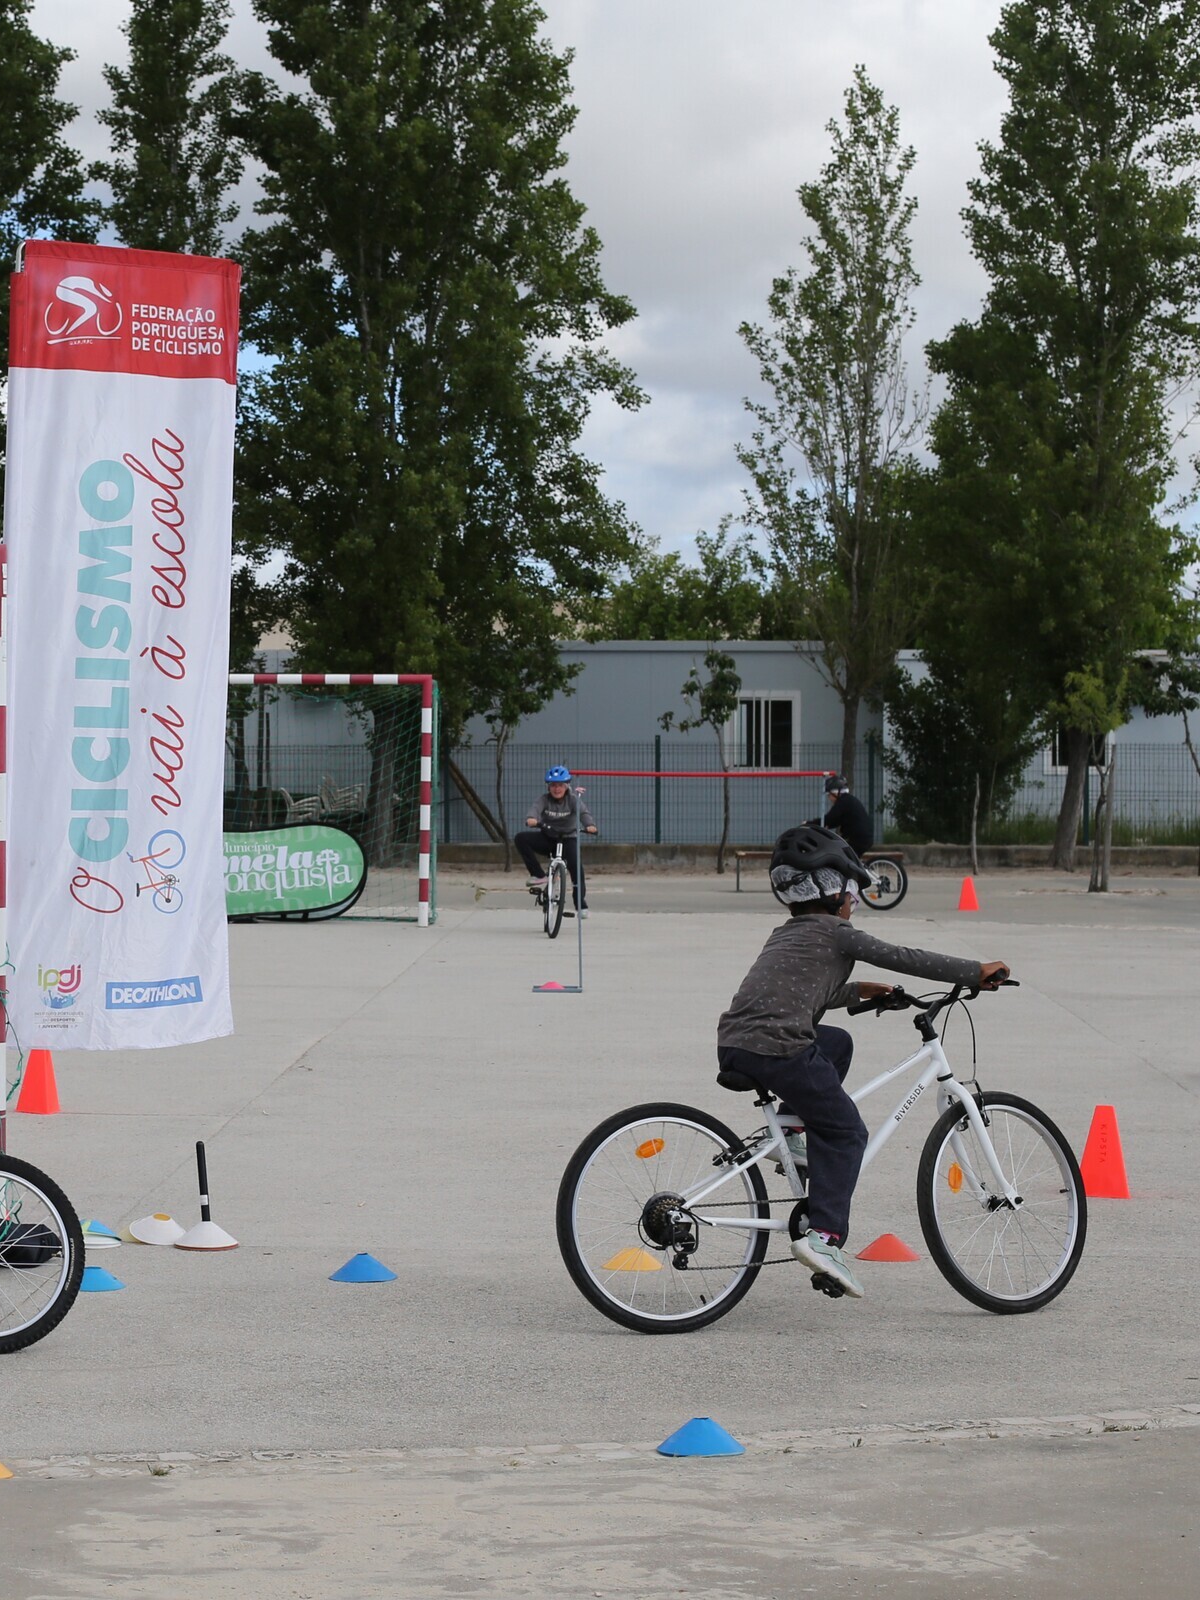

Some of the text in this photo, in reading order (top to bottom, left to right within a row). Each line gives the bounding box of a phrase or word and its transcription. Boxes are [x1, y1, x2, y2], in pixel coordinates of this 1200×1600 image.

[131, 303, 216, 326] FEDERAÇÃO
[131, 321, 225, 341] PORTUGUESA
[131, 337, 222, 356] DE CICLISMO
[122, 427, 188, 816] vai à escola
[68, 459, 136, 863] CICLISMO
[223, 845, 315, 873] mela
[224, 864, 354, 900] onquista
[37, 963, 82, 994] ipdj
[111, 981, 197, 1004] DECATHLON
[894, 1083, 925, 1122] RIVERSIDE
[1098, 1123, 1108, 1163] KIPSTA
